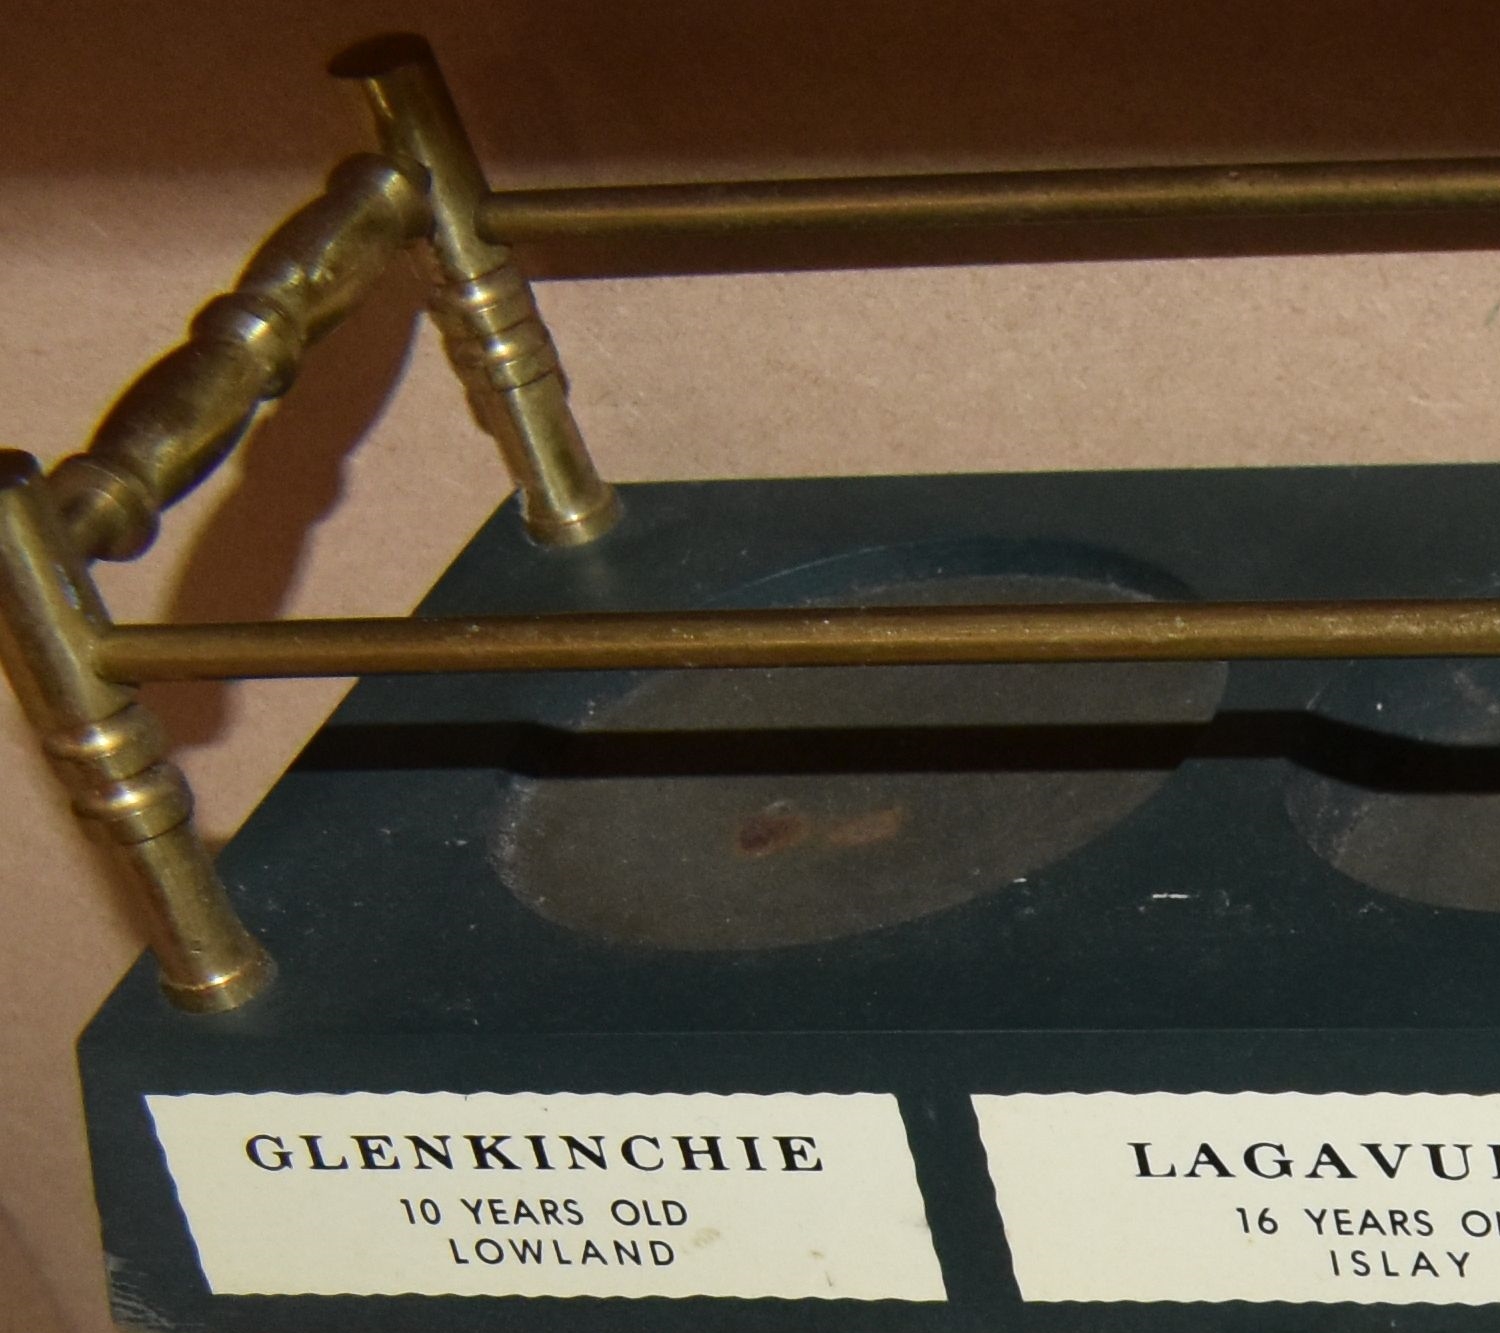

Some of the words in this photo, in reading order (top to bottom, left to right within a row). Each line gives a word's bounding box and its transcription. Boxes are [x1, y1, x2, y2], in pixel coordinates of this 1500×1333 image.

[246, 1135, 823, 1172] GLENKINCHIE
[400, 1198, 441, 1225] 10
[460, 1198, 584, 1226] YEARS
[610, 1199, 688, 1226] OLD
[1236, 1207, 1278, 1235] 16
[1304, 1208, 1434, 1237] YEARS
[448, 1238, 674, 1266] LOWLAND
[1330, 1250, 1470, 1278] ISLAY
